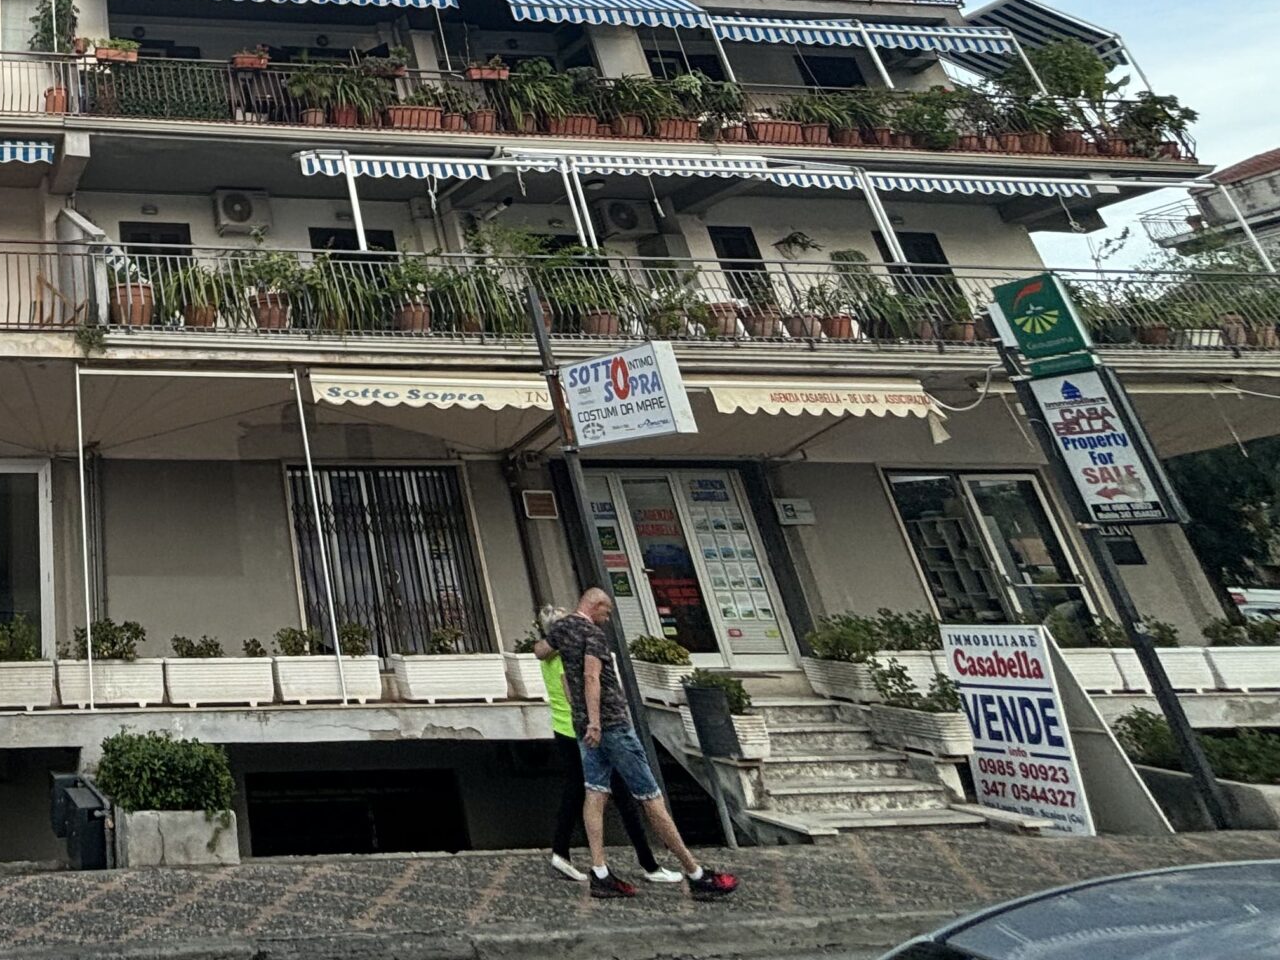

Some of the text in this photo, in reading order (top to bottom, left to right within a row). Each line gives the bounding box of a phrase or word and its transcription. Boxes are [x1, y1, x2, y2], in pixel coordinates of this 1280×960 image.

[627, 355, 654, 371] INTIMO
[326, 387, 399, 400] Sotto
[406, 388, 485, 402] Sopra
[770, 393, 800, 403] AGENZIA
[800, 393, 841, 403] CASABELLA
[847, 393, 859, 404] DE
[858, 393, 878, 404] LUCA
[577, 396, 666, 423] COSTUMI DA MARE
[1059, 406, 1117, 421] CASA
[1051, 419, 1118, 437] BELLA
[1060, 433, 1129, 451] Property
[1088, 451, 1115, 466] For
[947, 634, 1037, 647] IMMOBILIARE
[953, 648, 1045, 679] Casabella
[960, 693, 1065, 747] VENDE
[1007, 746, 1027, 757] info
[978, 757, 1070, 784] 0985 90923
[981, 780, 1007, 797] 347
[1011, 783, 1076, 808] 0544327
